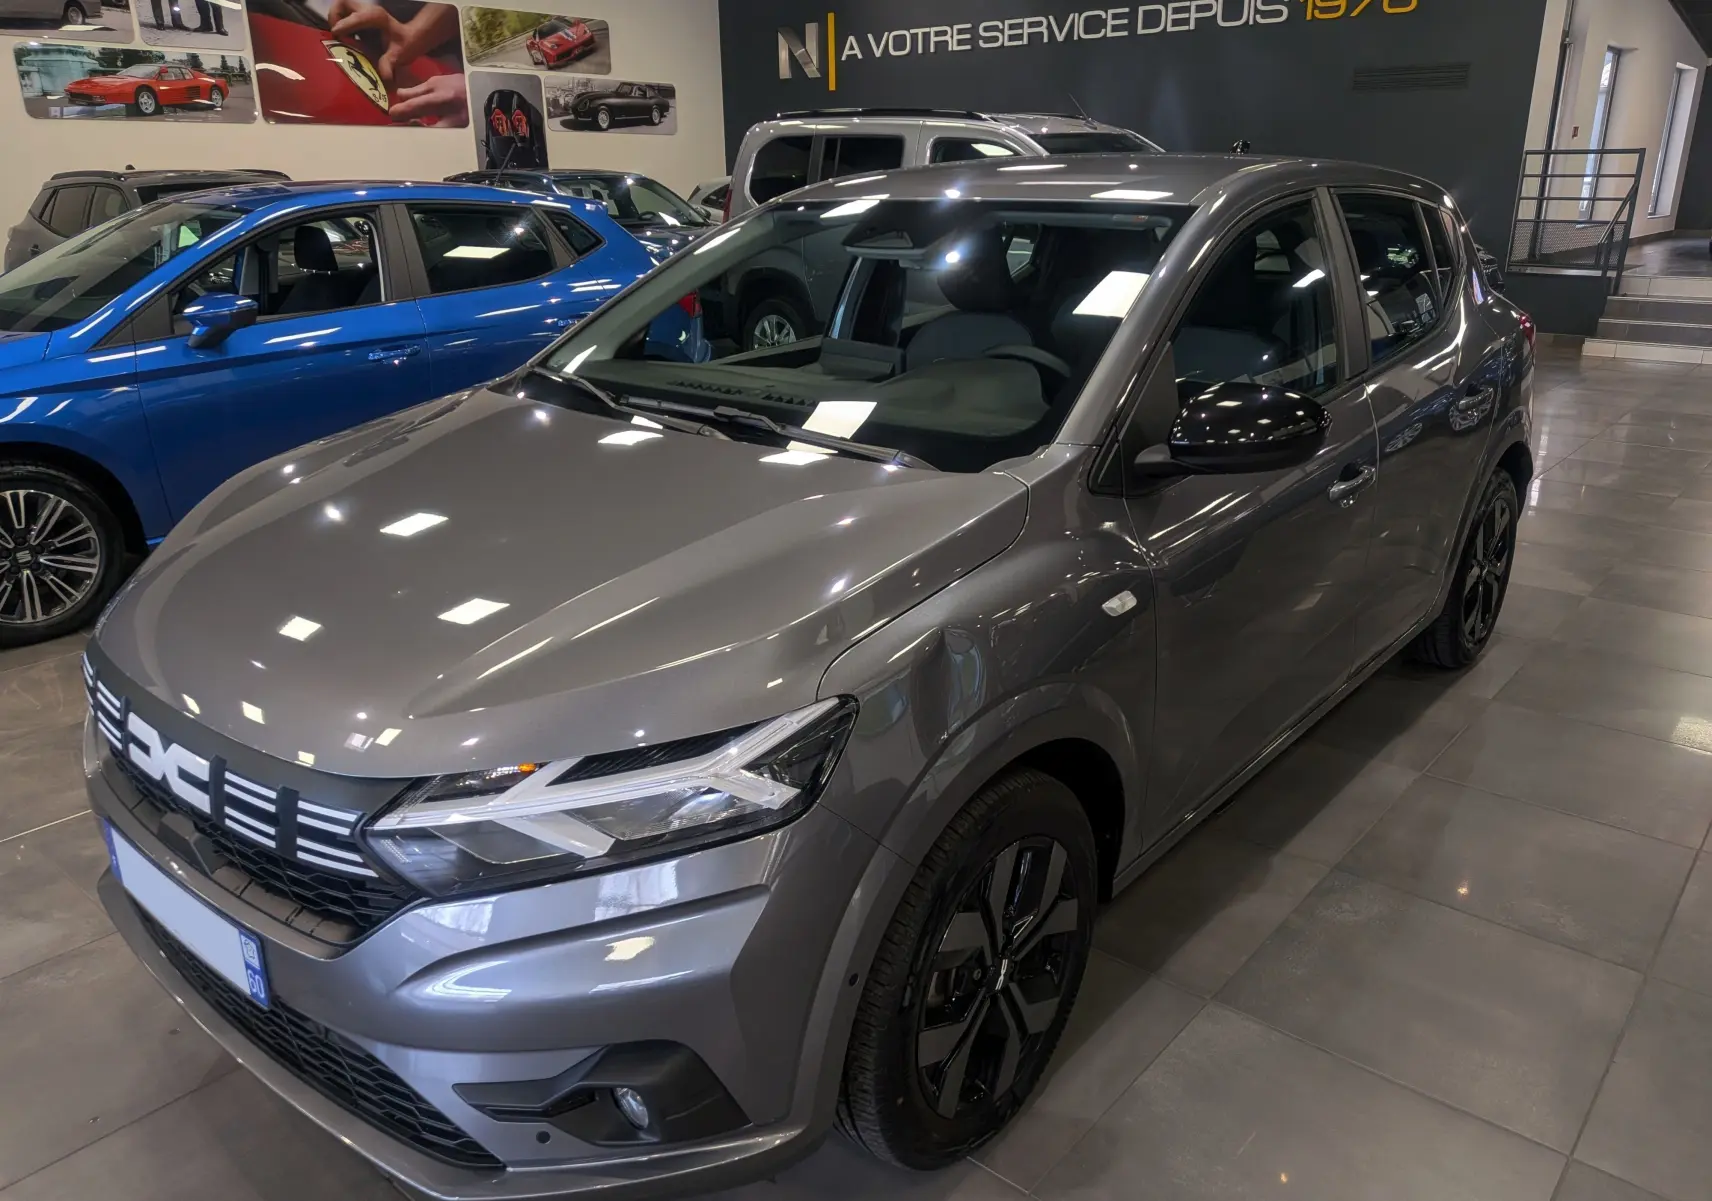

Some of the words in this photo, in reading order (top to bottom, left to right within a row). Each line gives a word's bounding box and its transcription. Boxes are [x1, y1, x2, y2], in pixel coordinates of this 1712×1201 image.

[778, 22, 821, 79] N
[841, 35, 863, 61] A
[867, 23, 973, 58] VOTRE
[978, 7, 1130, 48] SERVICE
[1137, 0, 1289, 35] DEPUIS
[247, 968, 265, 998] 60
